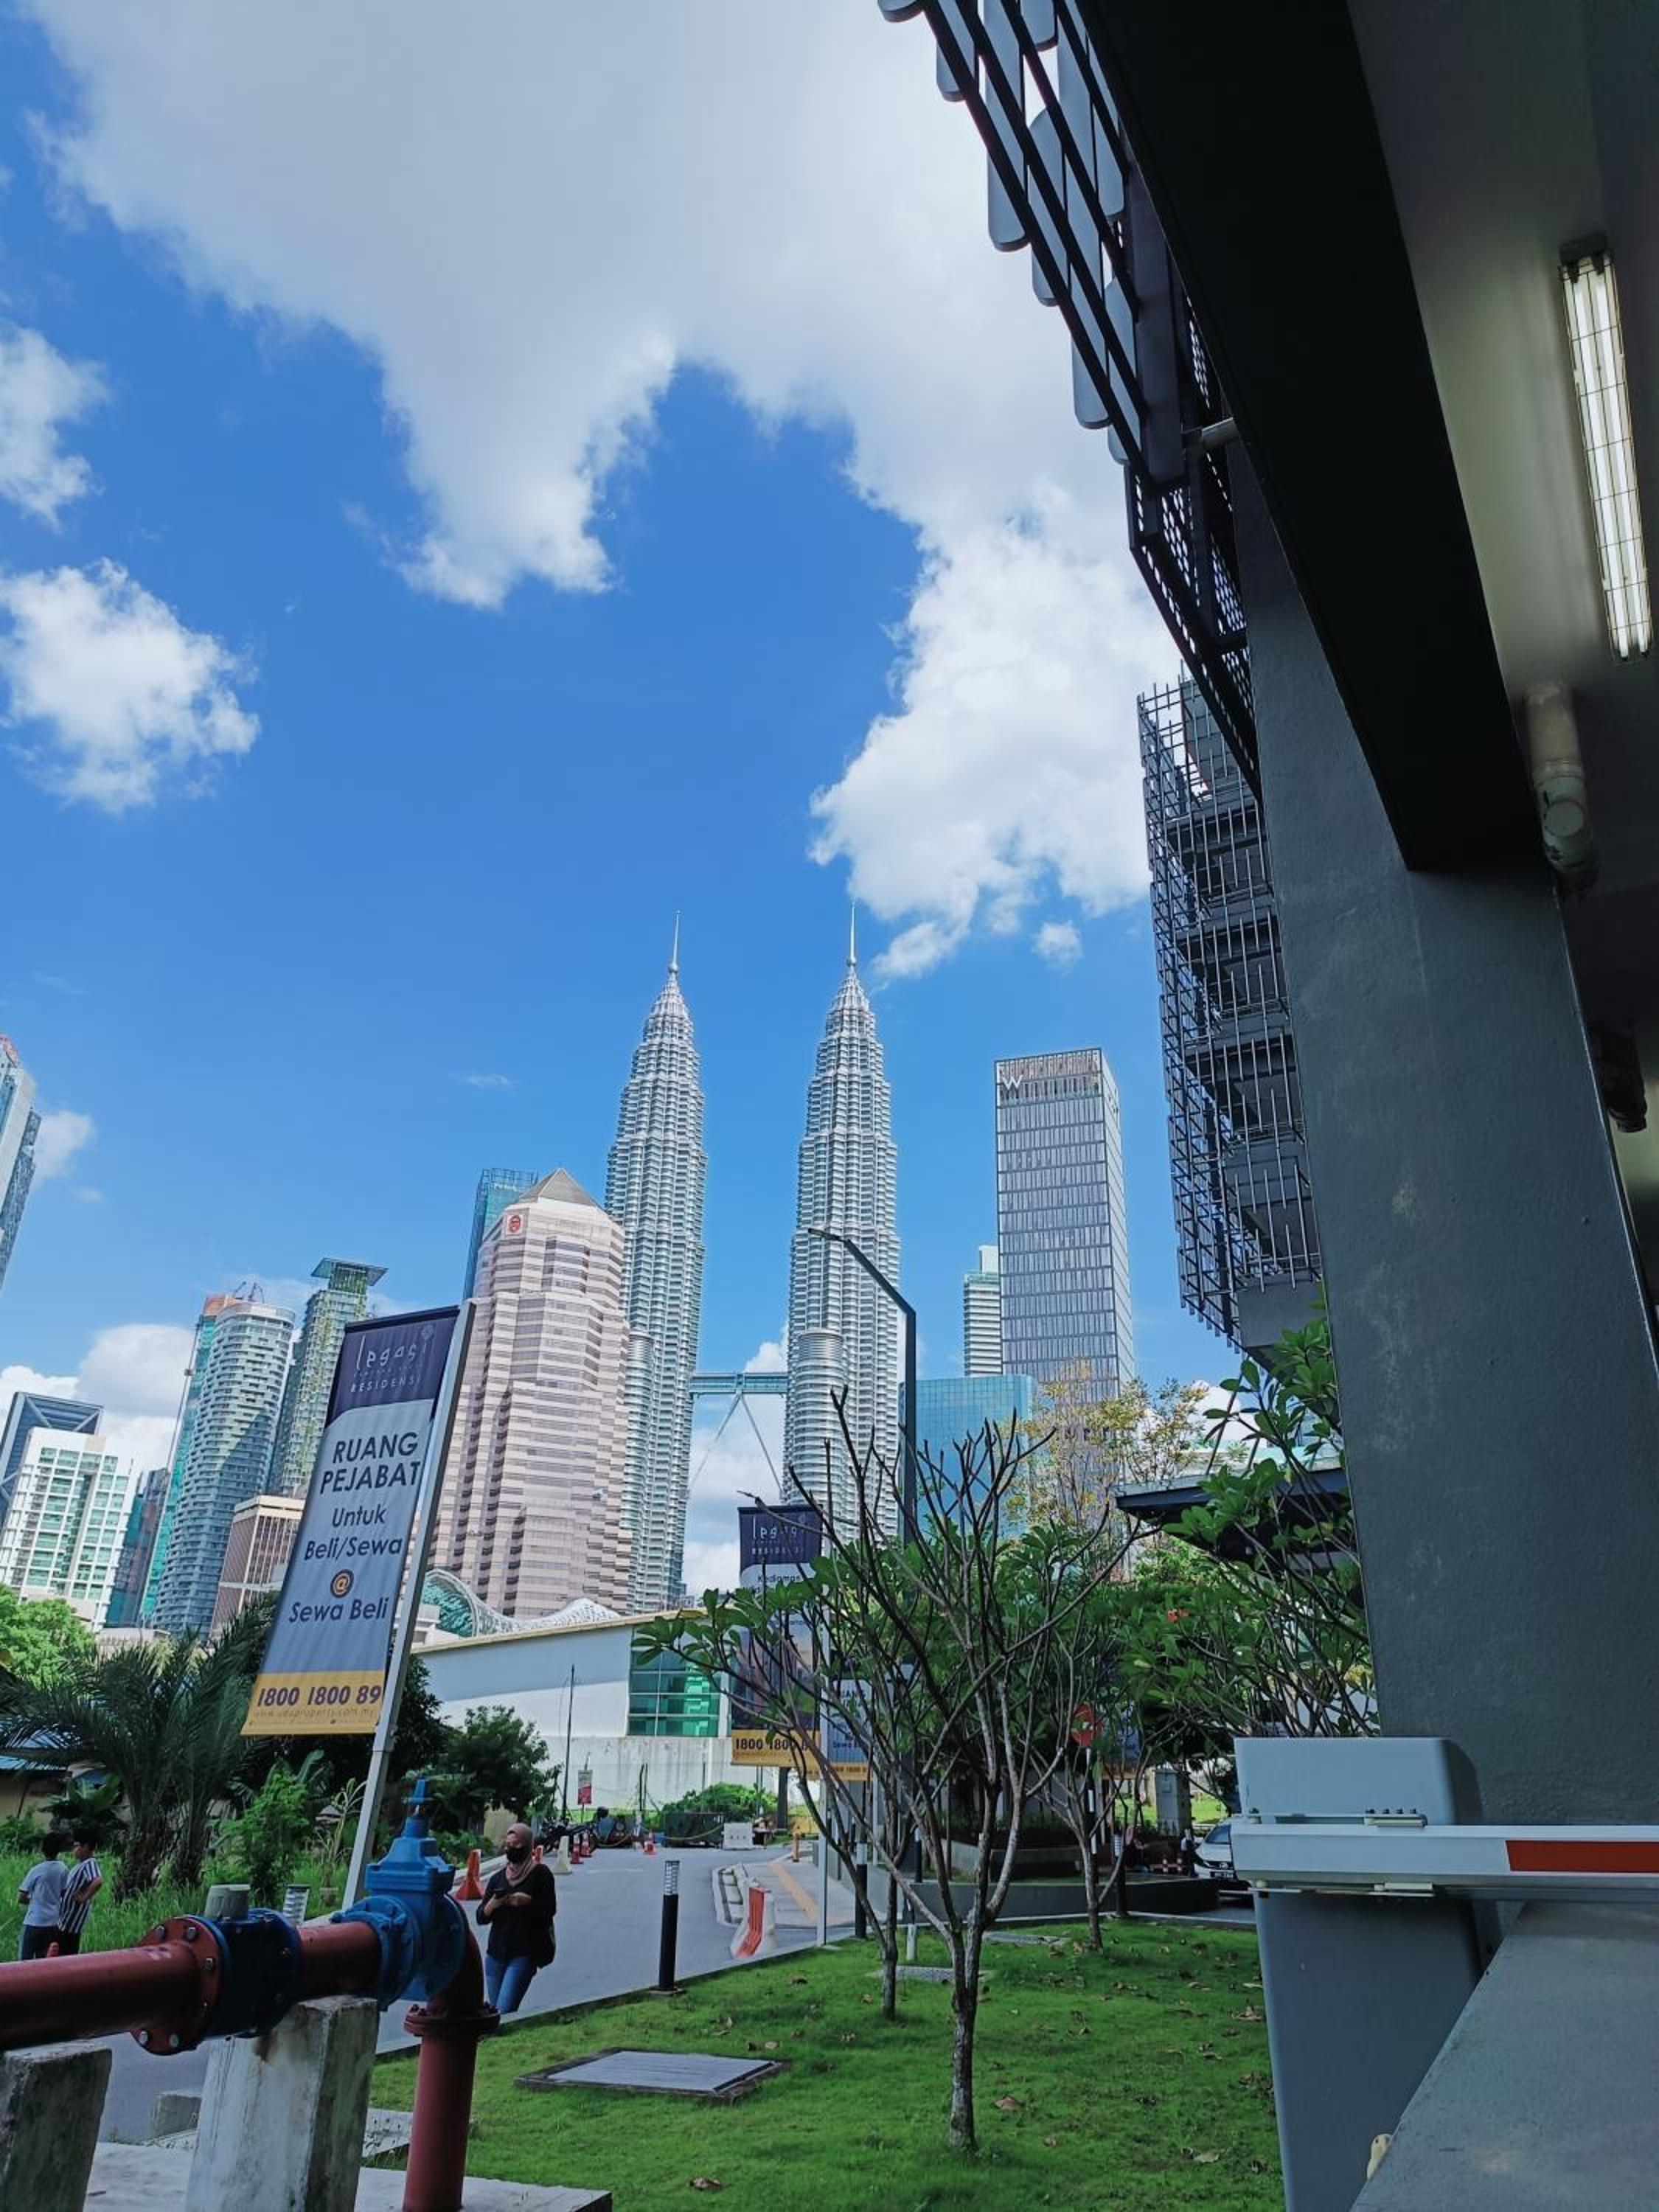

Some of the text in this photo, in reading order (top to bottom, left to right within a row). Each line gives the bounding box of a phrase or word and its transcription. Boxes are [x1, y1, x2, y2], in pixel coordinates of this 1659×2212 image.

[1002, 1074, 1023, 1091] W
[350, 1374, 421, 1393] RESIDENSI
[333, 1432, 418, 1464] RUANG
[320, 1461, 420, 1494] PEJABAT
[332, 1503, 387, 1528] Untuk
[304, 1536, 403, 1561] Beli/Sewa
[288, 1596, 390, 1623] Sewa Beli
[257, 1686, 300, 1708] 1800
[307, 1685, 352, 1706] 1800
[735, 1739, 763, 1750] 1800
